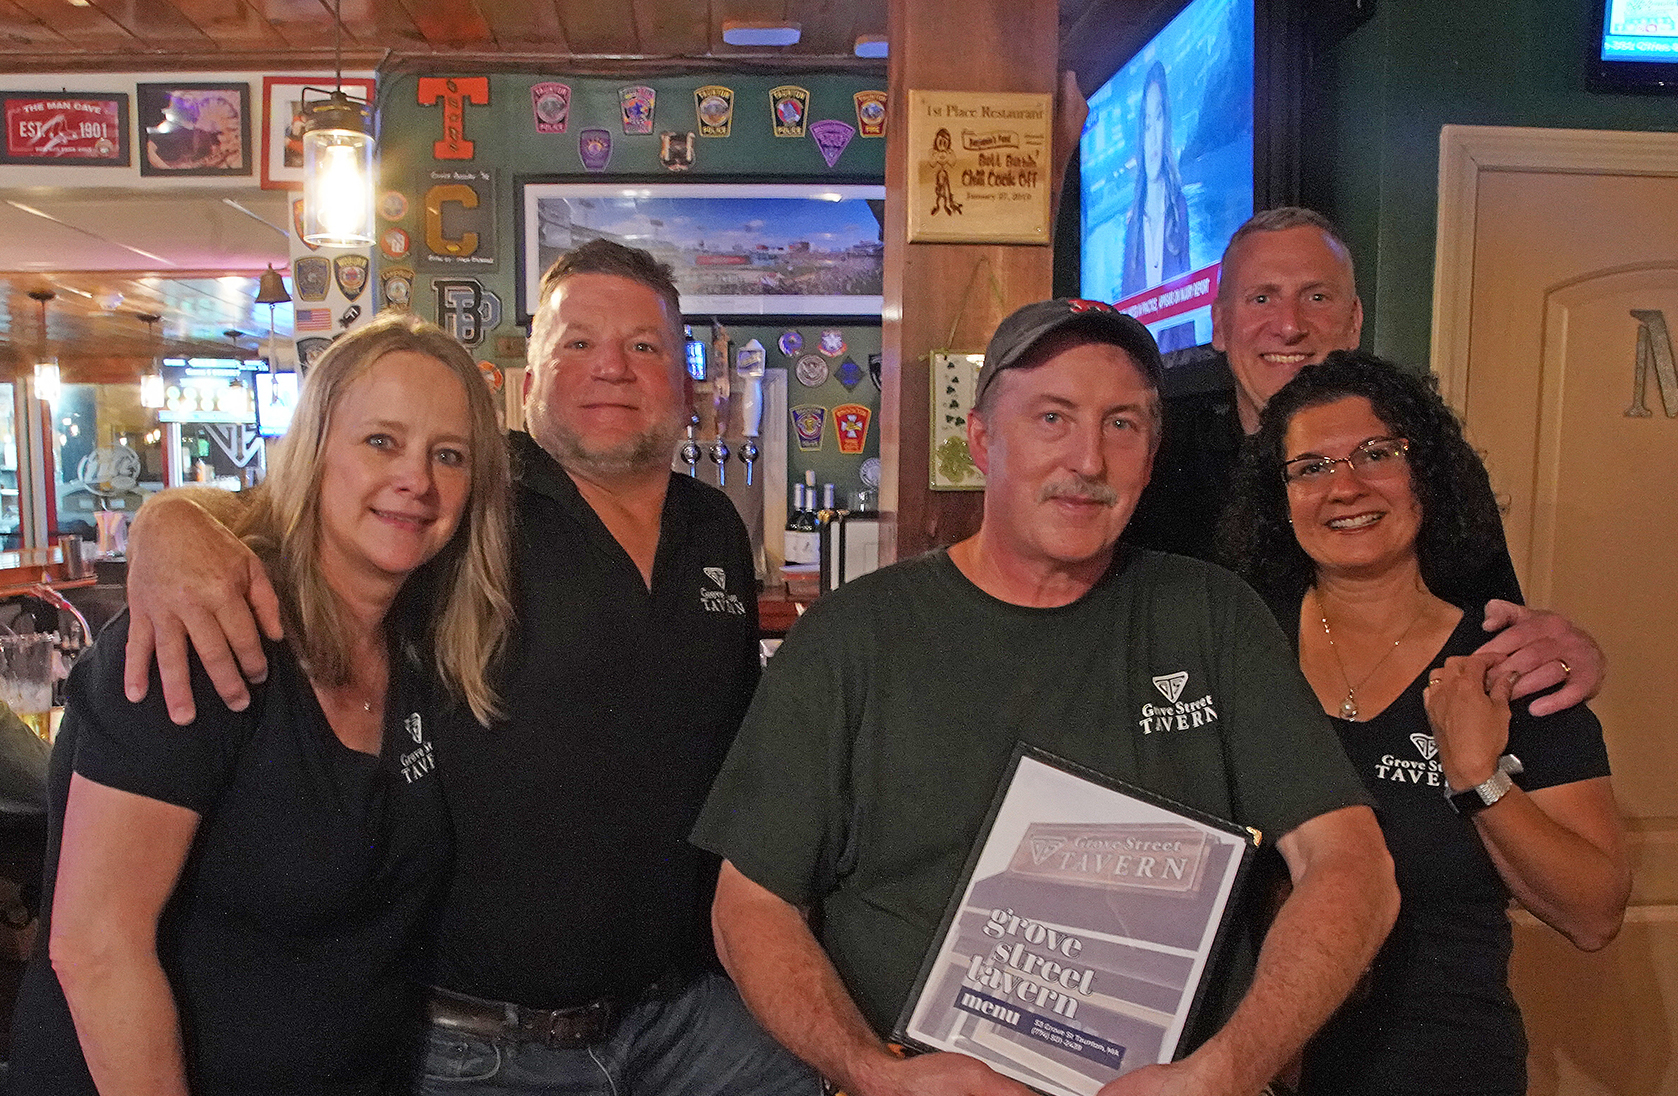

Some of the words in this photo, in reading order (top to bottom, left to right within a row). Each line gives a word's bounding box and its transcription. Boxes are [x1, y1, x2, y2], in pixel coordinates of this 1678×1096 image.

[22, 103, 45, 113] THE
[46, 101, 71, 111] MAN
[73, 103, 101, 114] CAVE
[927, 105, 942, 117] 1st
[946, 104, 977, 118] Place
[981, 105, 1044, 120] Restaurant
[79, 121, 107, 138] 1901
[425, 185, 478, 257] C
[1175, 694, 1213, 715] Street
[1381, 754, 1426, 770] Grove
[1374, 764, 1440, 787] TAVE
[1074, 835, 1123, 850] Grove
[1124, 836, 1183, 852] Street
[1059, 851, 1189, 881] TAVERN
[982, 907, 1083, 960] grove
[991, 941, 1097, 997] street
[966, 953, 1080, 1020] tavern
[961, 992, 1021, 1026] menu
